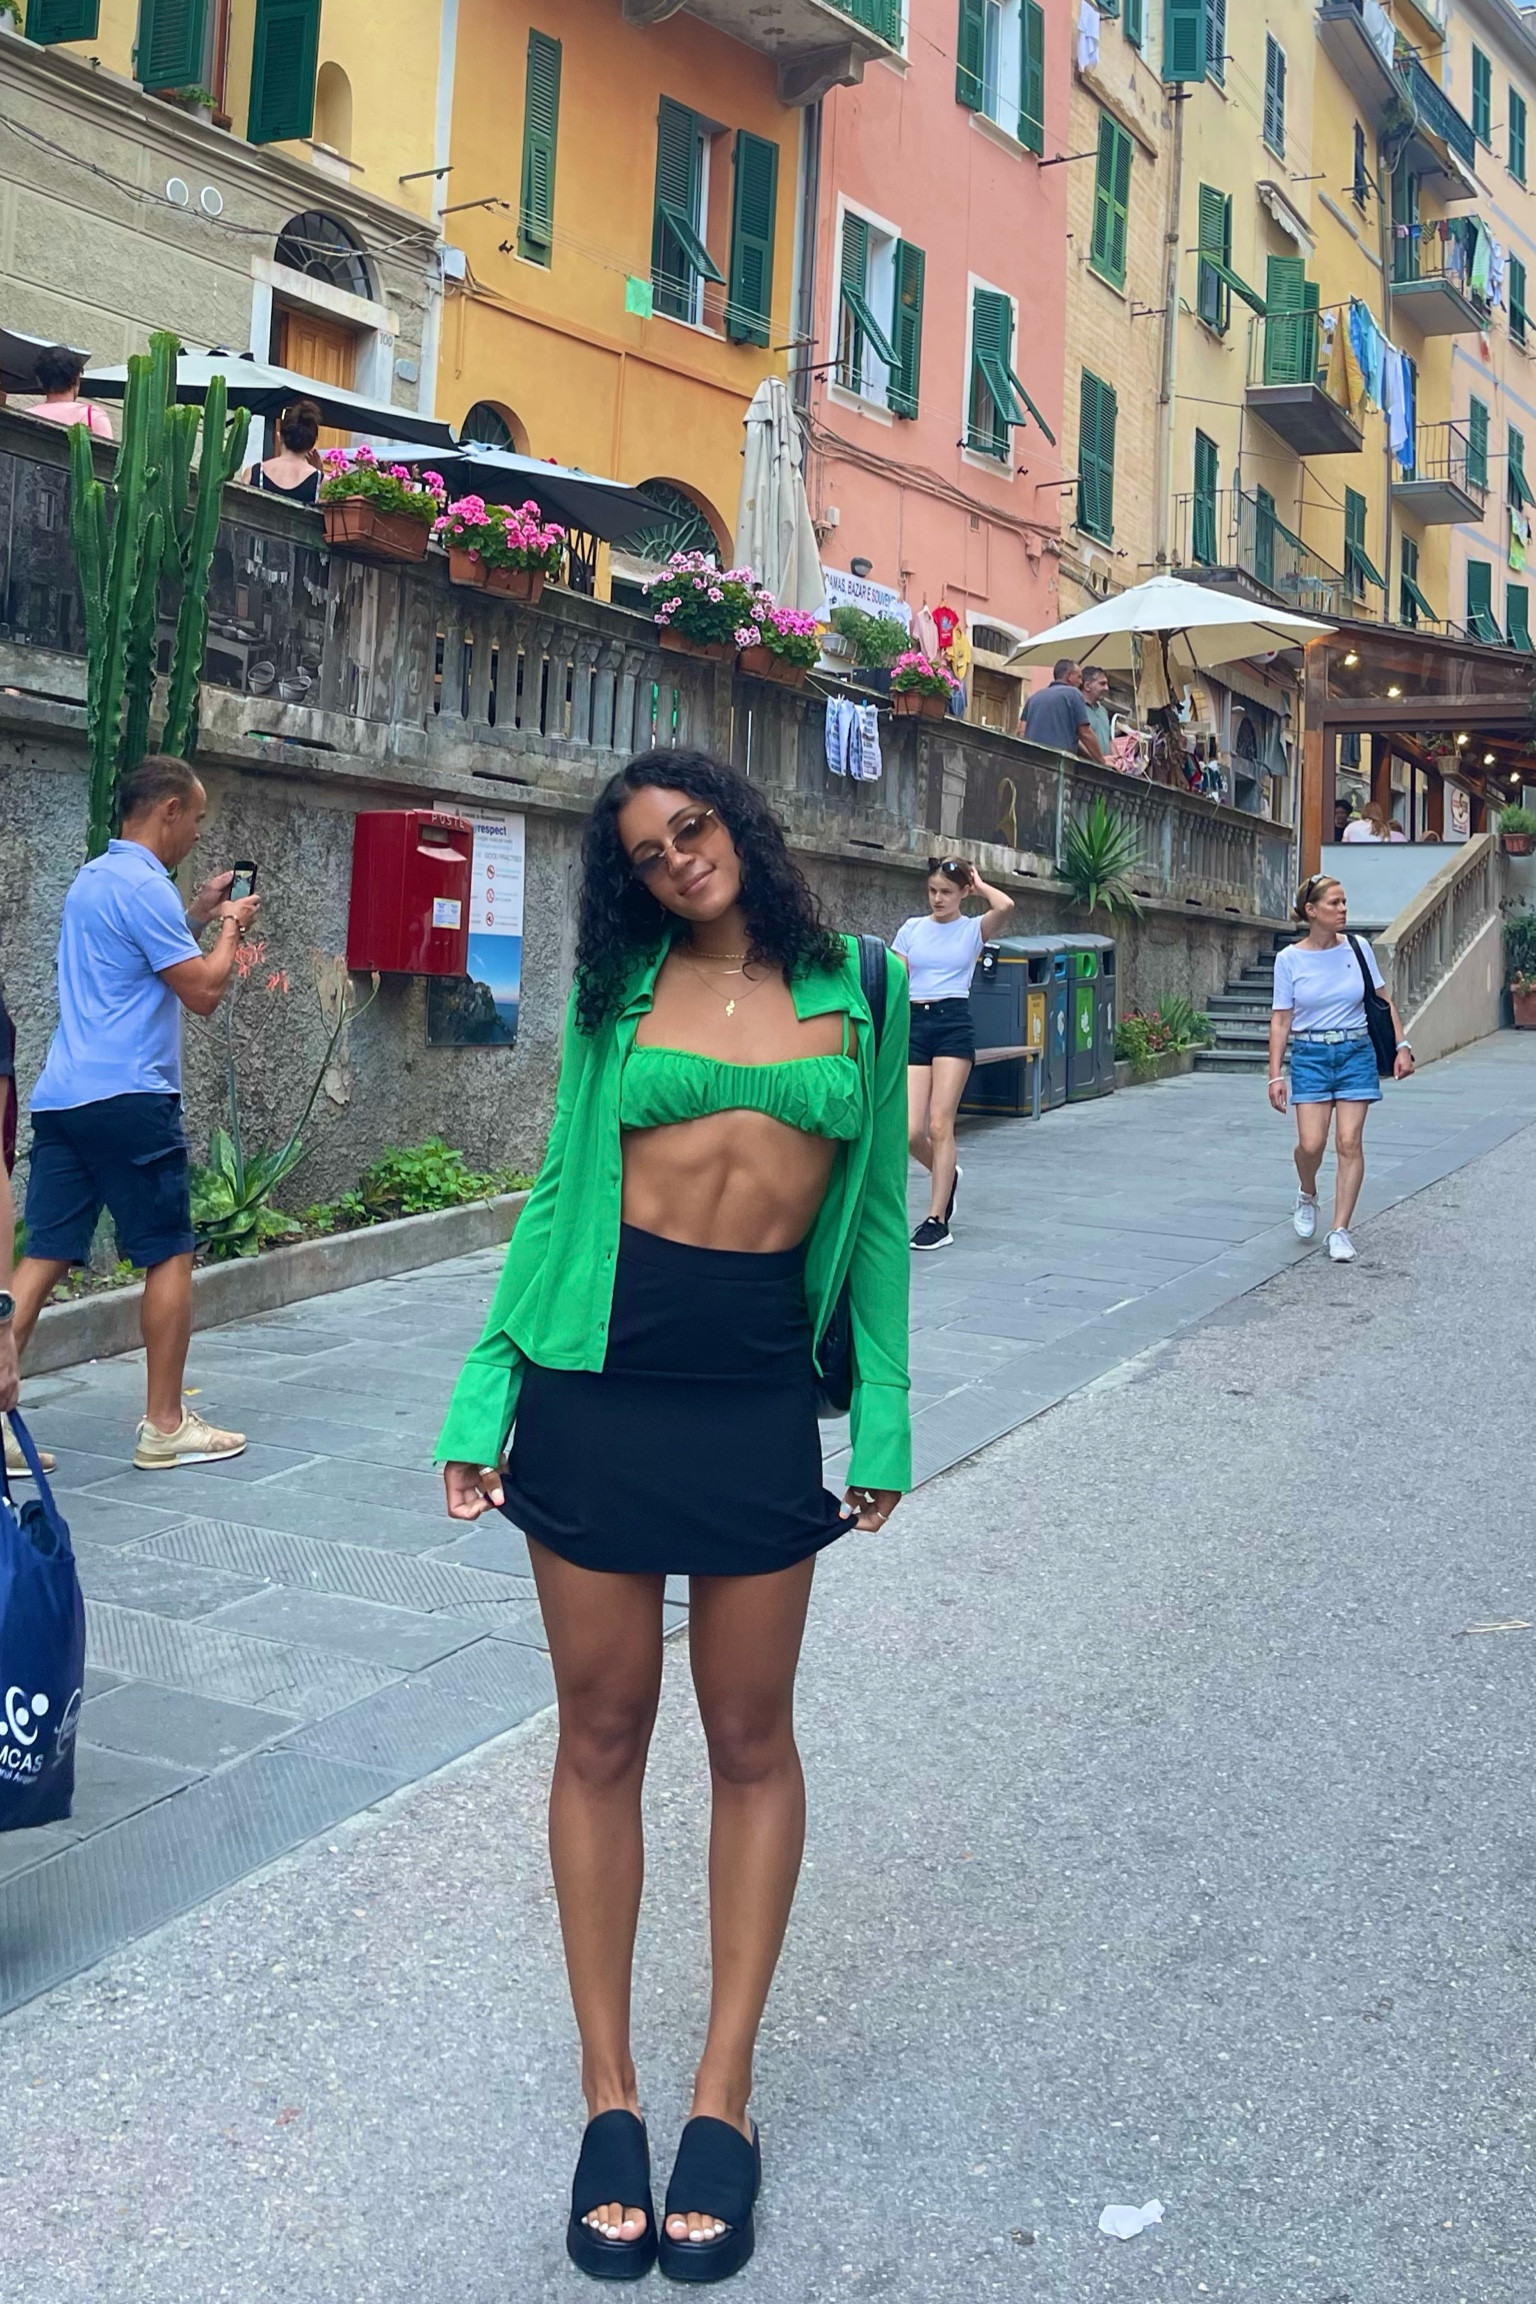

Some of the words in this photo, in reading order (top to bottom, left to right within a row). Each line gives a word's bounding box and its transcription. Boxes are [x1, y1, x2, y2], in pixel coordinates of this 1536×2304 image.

[379, 332, 394, 348] 100
[848, 581, 866, 599] BAZAR
[867, 586, 871, 601] E
[431, 813, 464, 828] POSTE
